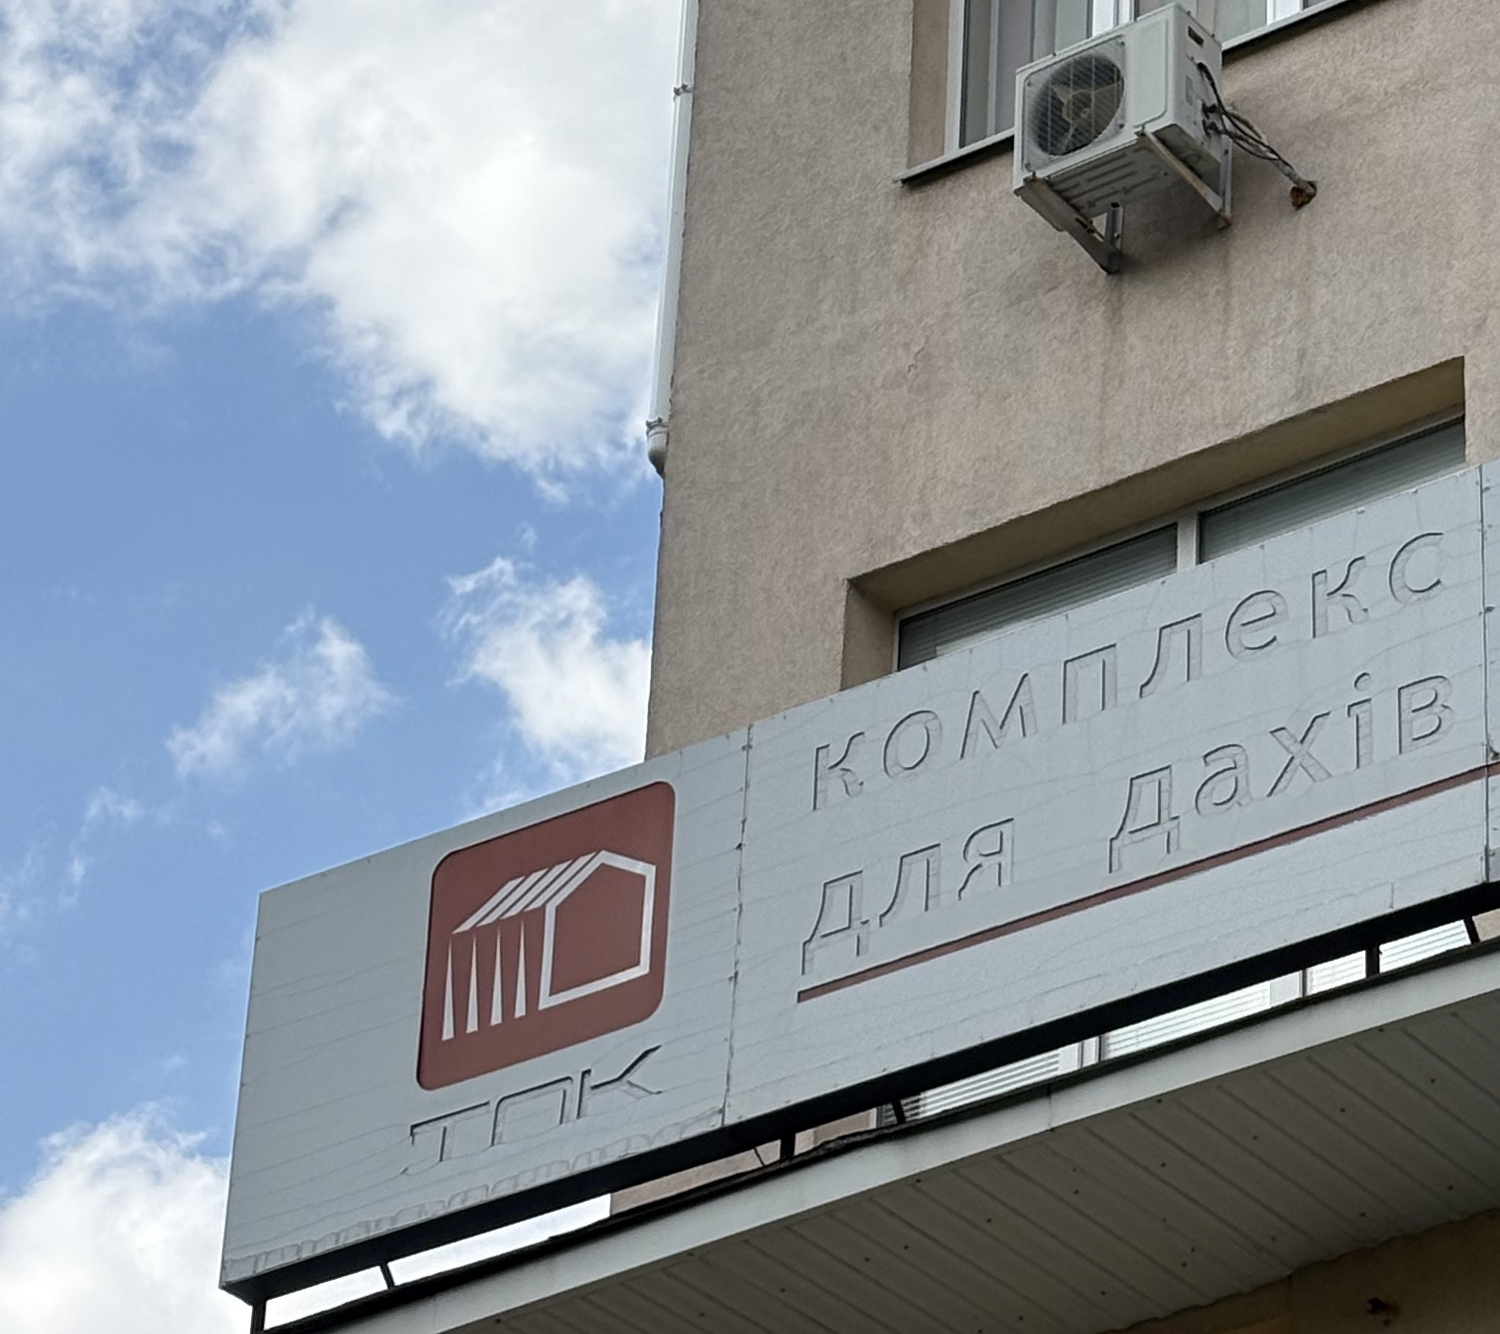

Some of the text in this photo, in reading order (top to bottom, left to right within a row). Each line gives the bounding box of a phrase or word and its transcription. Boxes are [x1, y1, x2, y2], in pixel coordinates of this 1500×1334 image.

[801, 817, 1014, 976] для
[1109, 671, 1454, 874] дахів
[409, 1044, 663, 1163] ТПК
